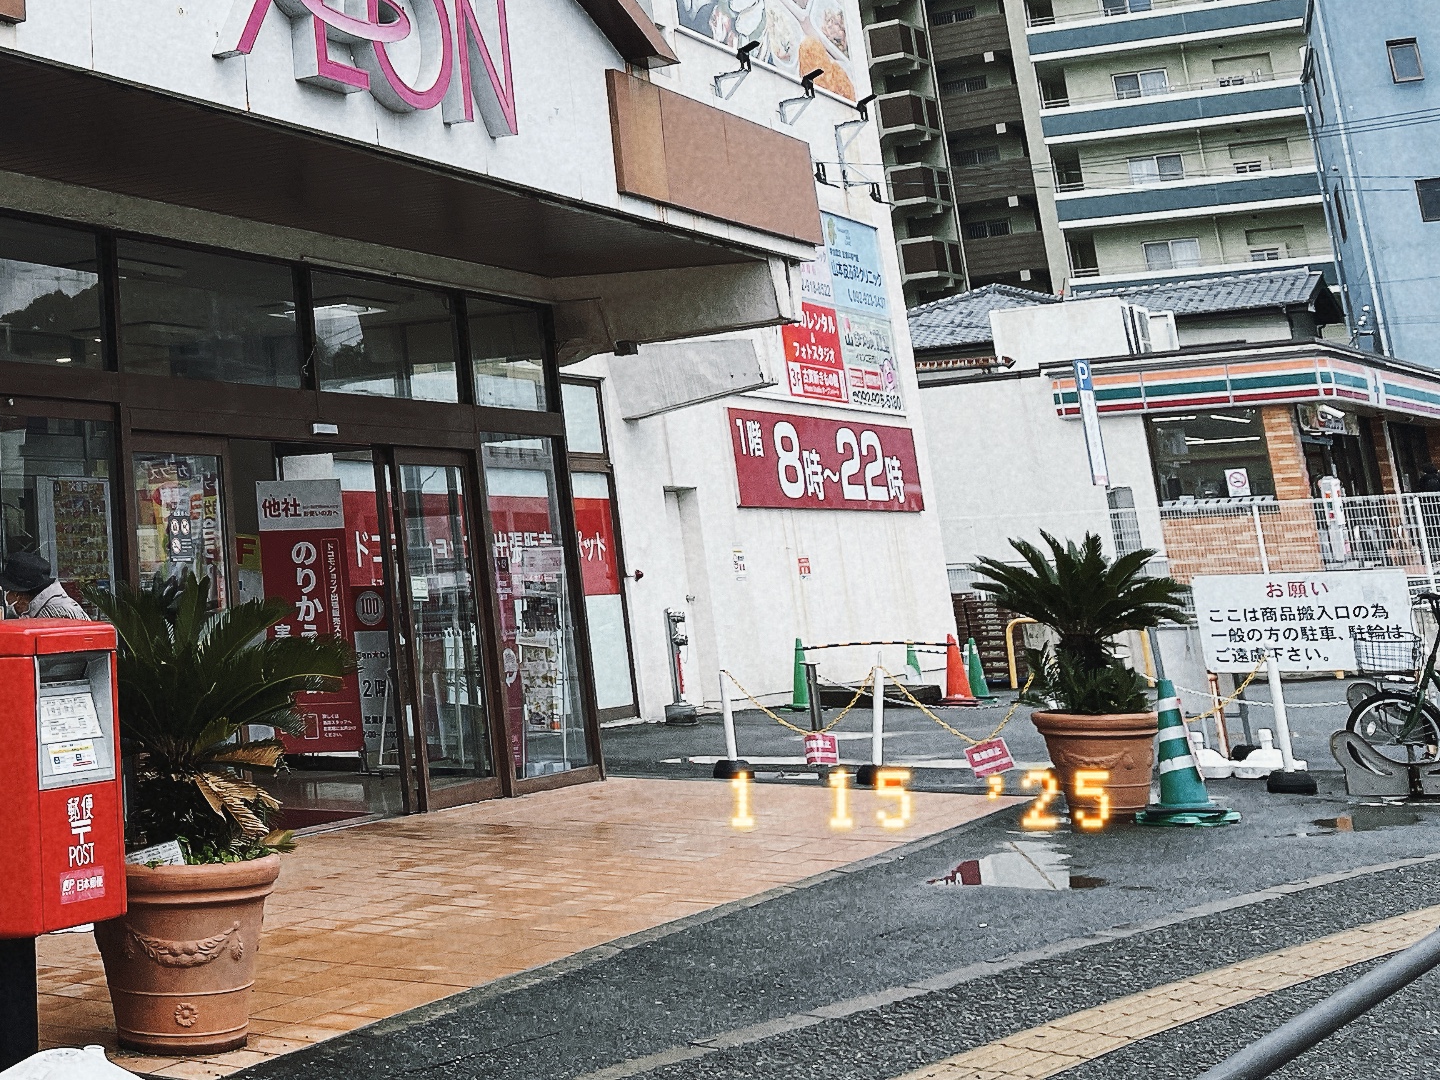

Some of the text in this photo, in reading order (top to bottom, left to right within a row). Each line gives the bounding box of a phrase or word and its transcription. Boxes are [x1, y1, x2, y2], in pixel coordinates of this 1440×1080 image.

[792, 341, 835, 364] フォトスタジオ
[1076, 361, 1089, 389] P
[735, 418, 765, 458] 1階
[261, 497, 302, 519] 他社
[1265, 580, 1330, 599] お願い
[1209, 603, 1390, 623] ここは商品搬入口の為
[67, 793, 95, 822] 郵便
[68, 842, 95, 868] POST
[76, 875, 105, 892] 日本郵便
